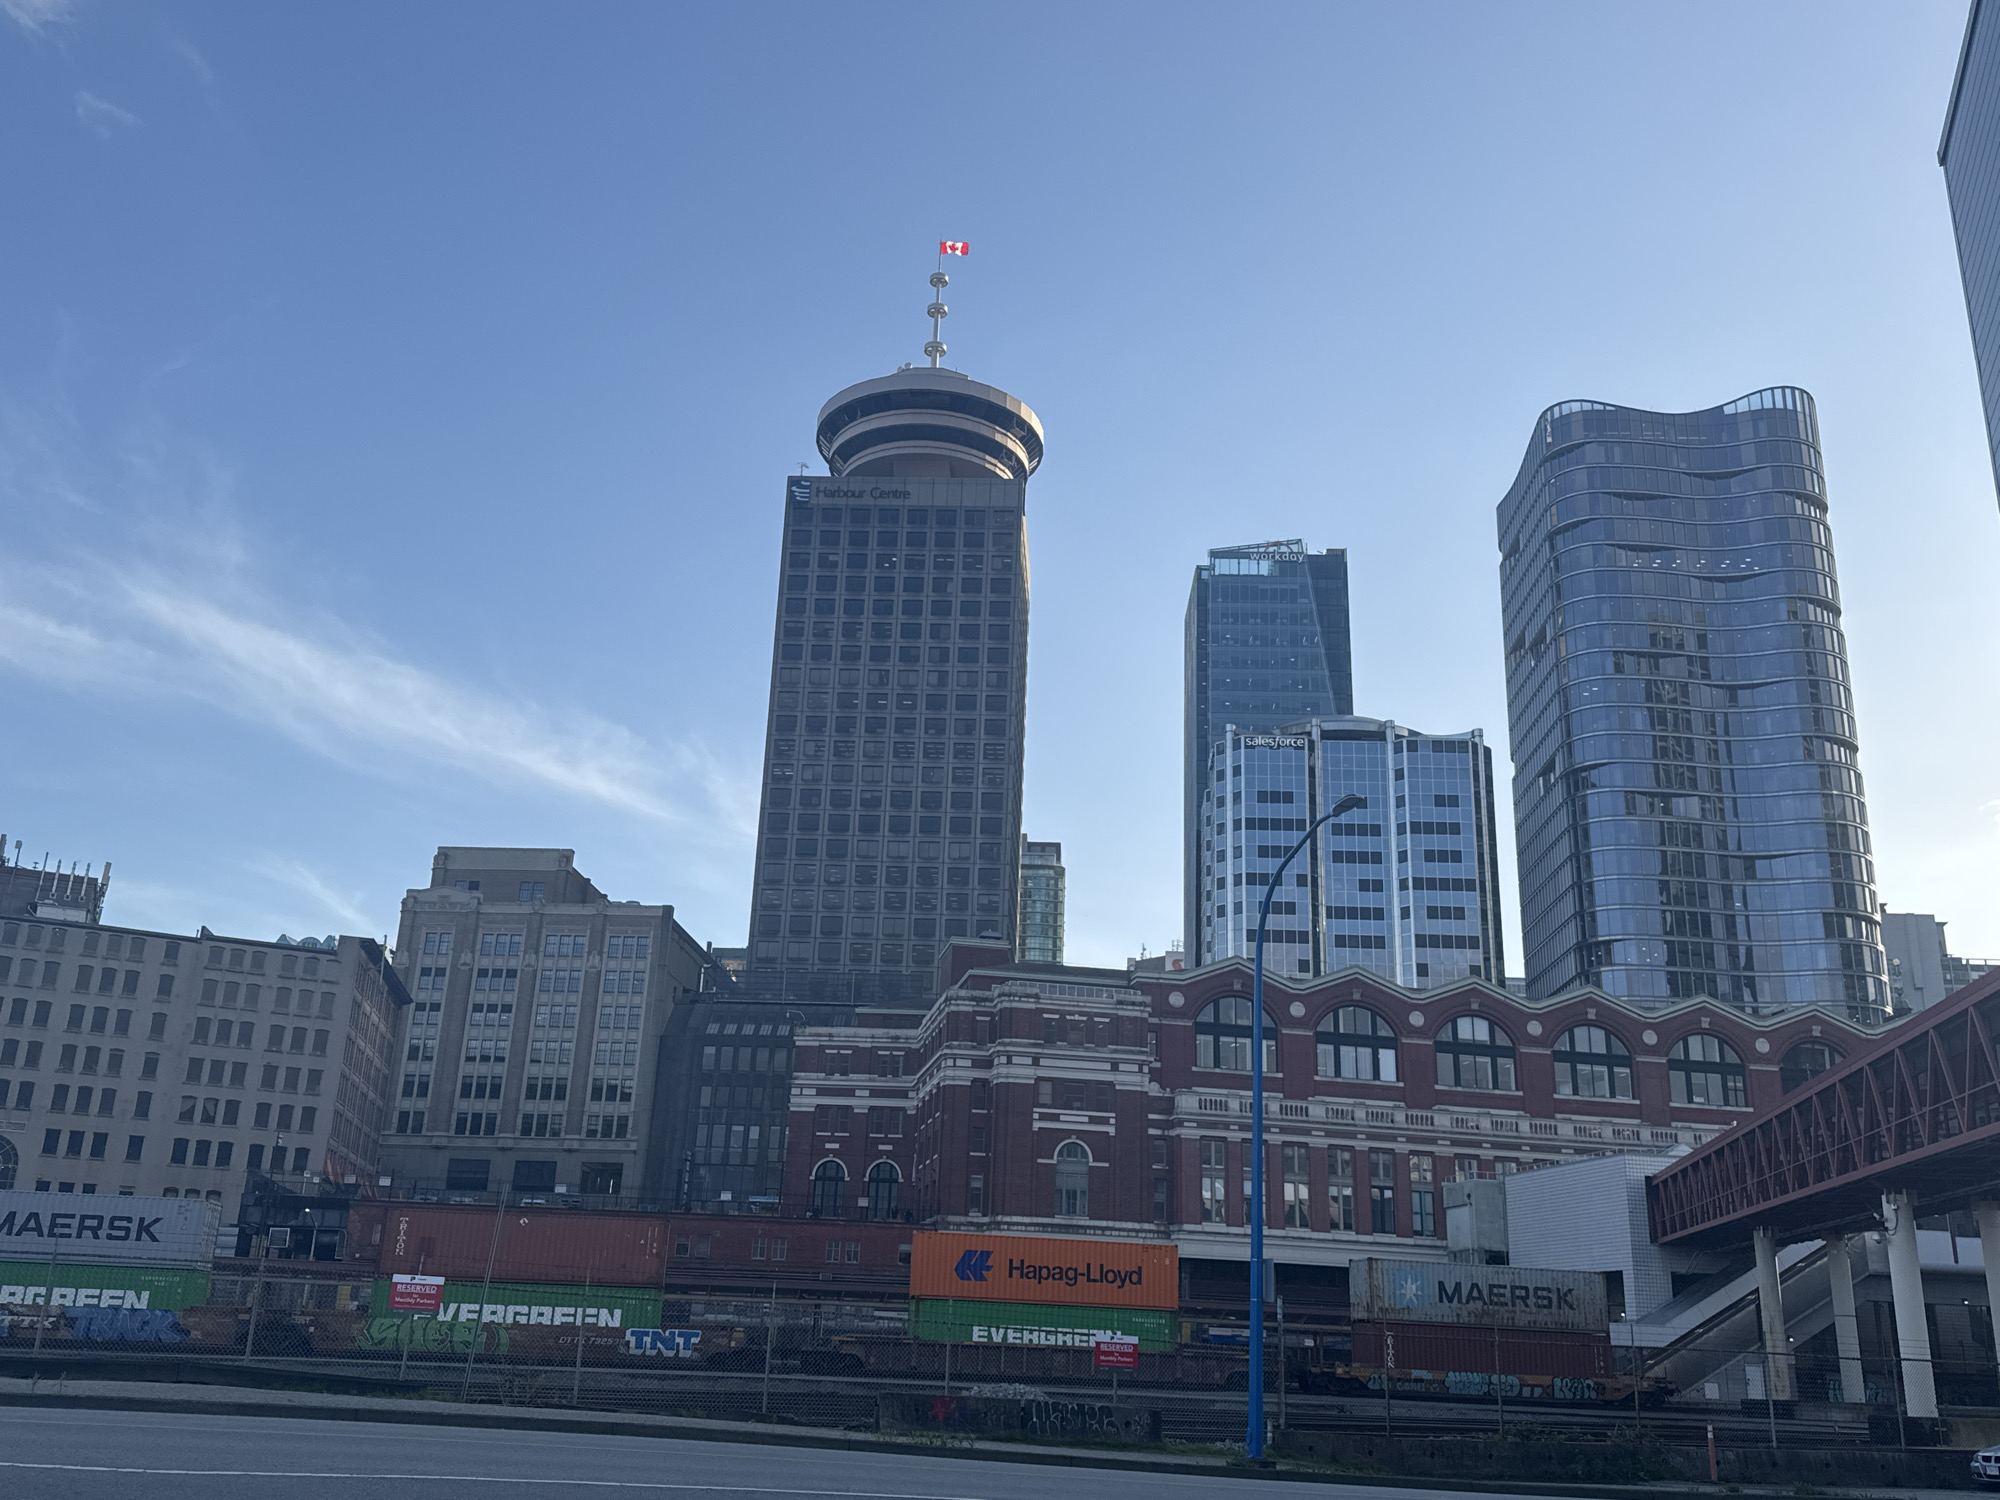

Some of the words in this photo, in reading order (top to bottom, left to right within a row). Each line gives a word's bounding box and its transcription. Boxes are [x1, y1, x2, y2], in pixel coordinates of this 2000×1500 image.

[815, 486, 866, 499] Harbour
[870, 486, 911, 500] Centre
[1250, 550, 1304, 563] workday
[1245, 736, 1304, 749] salesforce
[394, 1217, 410, 1255] TRITON
[1008, 1258, 1143, 1289] Hapag-Lloyd
[396, 1284, 438, 1294] RESERVED
[1438, 1280, 1576, 1311] MAERSK
[413, 1302, 622, 1328] VERGREEN
[625, 1328, 701, 1358] TNT
[972, 1325, 1122, 1348] EVERGREE
[1100, 1343, 1134, 1352] RESERVED
